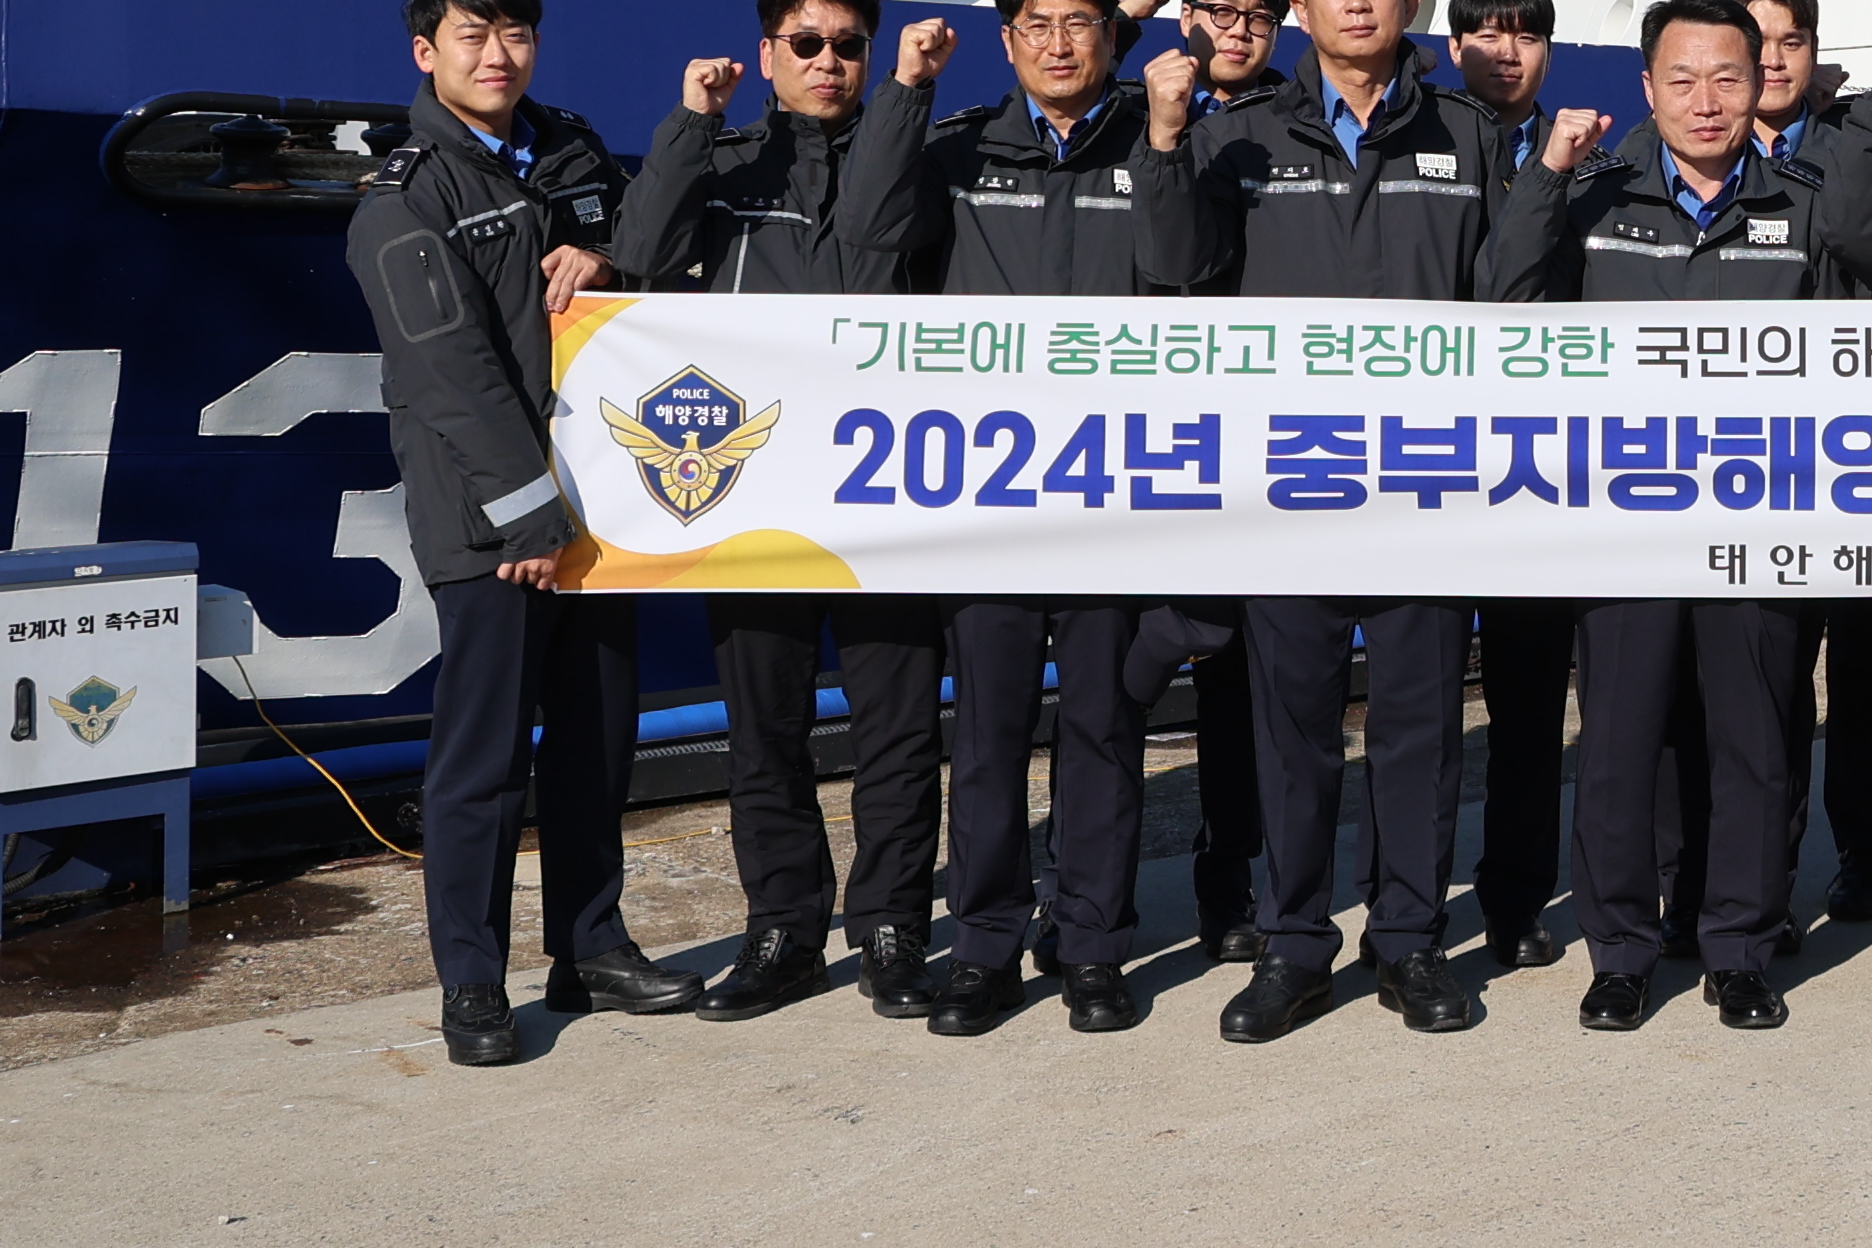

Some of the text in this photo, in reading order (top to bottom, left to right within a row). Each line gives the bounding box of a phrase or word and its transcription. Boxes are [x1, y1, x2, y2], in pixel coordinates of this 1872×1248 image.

[1418, 167, 1456, 180] POLICE
[1115, 184, 1132, 193] PO
[578, 211, 605, 225] POLICE
[1748, 234, 1788, 244] POLICE
[832, 318, 1025, 374] 「기본에
[1047, 323, 1277, 375] 충실하고
[1301, 324, 1476, 377] 현장에
[1498, 326, 1615, 378] 강한
[1635, 326, 1808, 380] 국민의
[672, 388, 710, 400] POLICE
[655, 404, 729, 426] 해양경찰
[833, 407, 1223, 511] 2024년
[7, 607, 179, 642] 관계자 외 촉수금지
